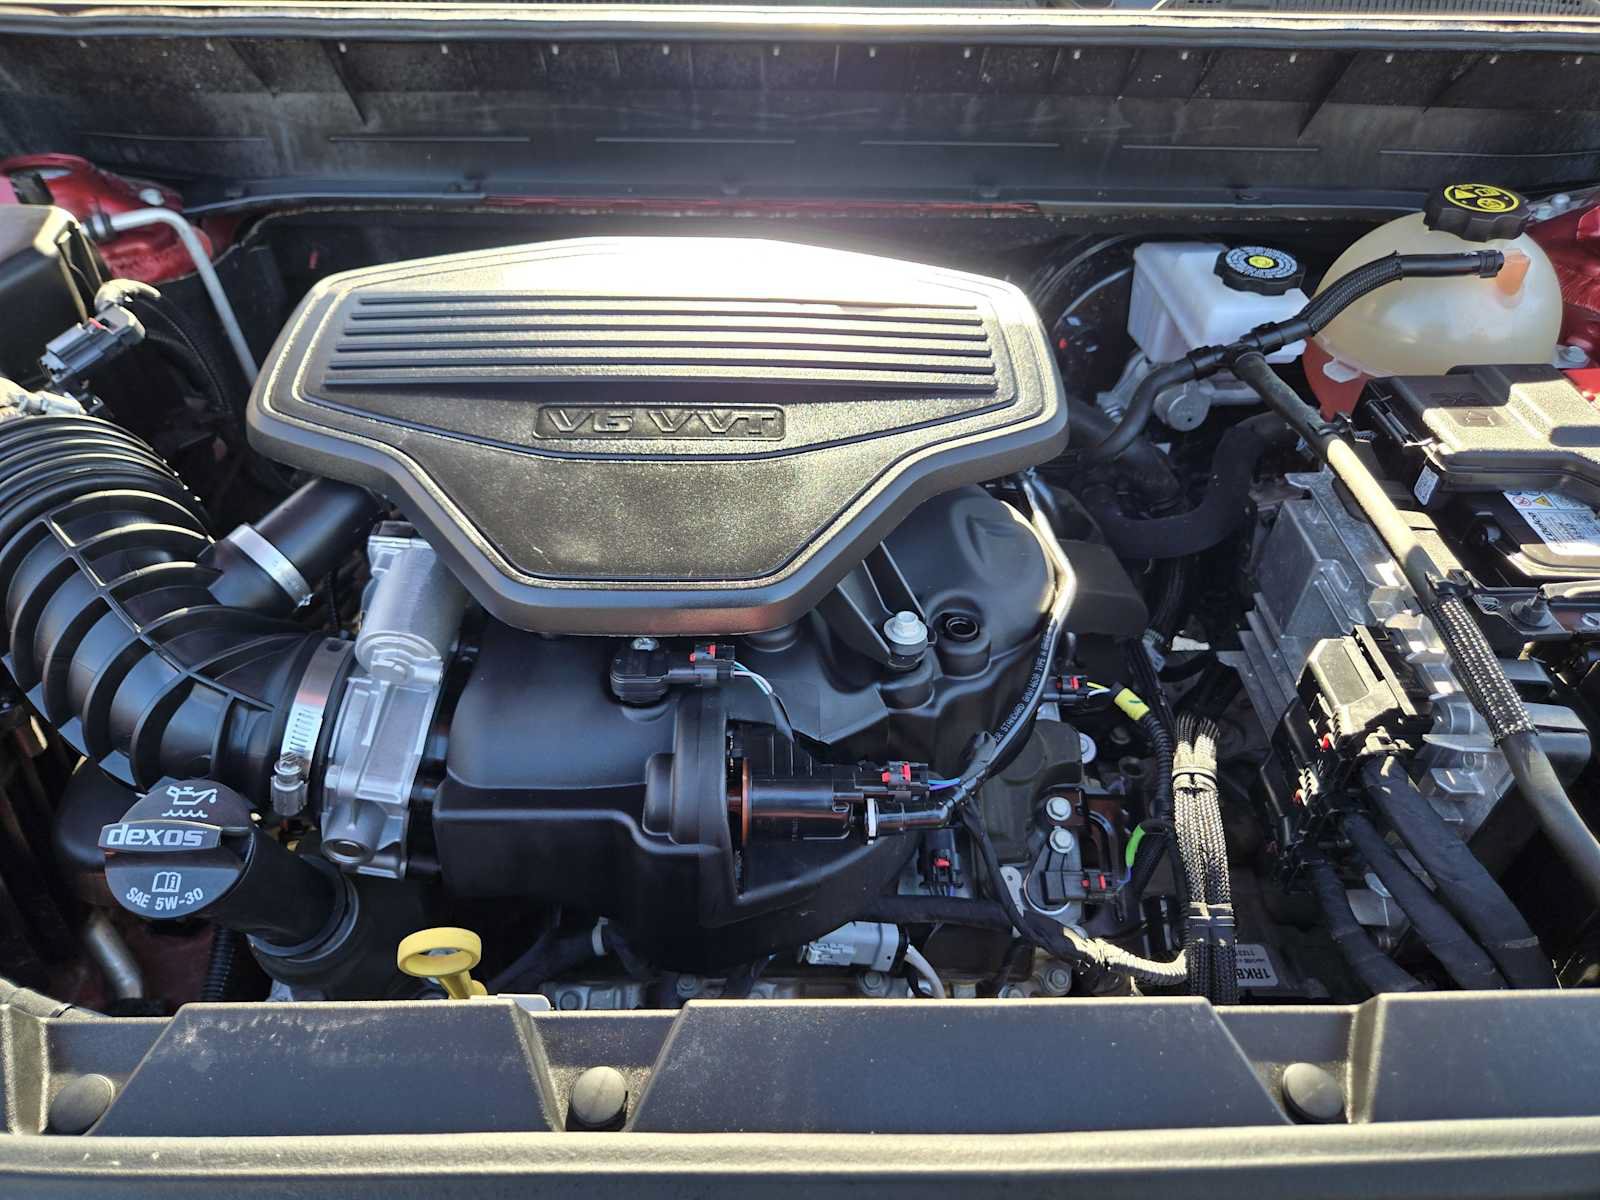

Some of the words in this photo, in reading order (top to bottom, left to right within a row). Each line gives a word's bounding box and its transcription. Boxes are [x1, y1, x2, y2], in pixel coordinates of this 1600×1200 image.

[547, 409, 633, 433] V6
[647, 409, 777, 435] VVT
[106, 823, 204, 847] dexos
[126, 887, 151, 908] SAE
[154, 887, 205, 911] 5W-30
